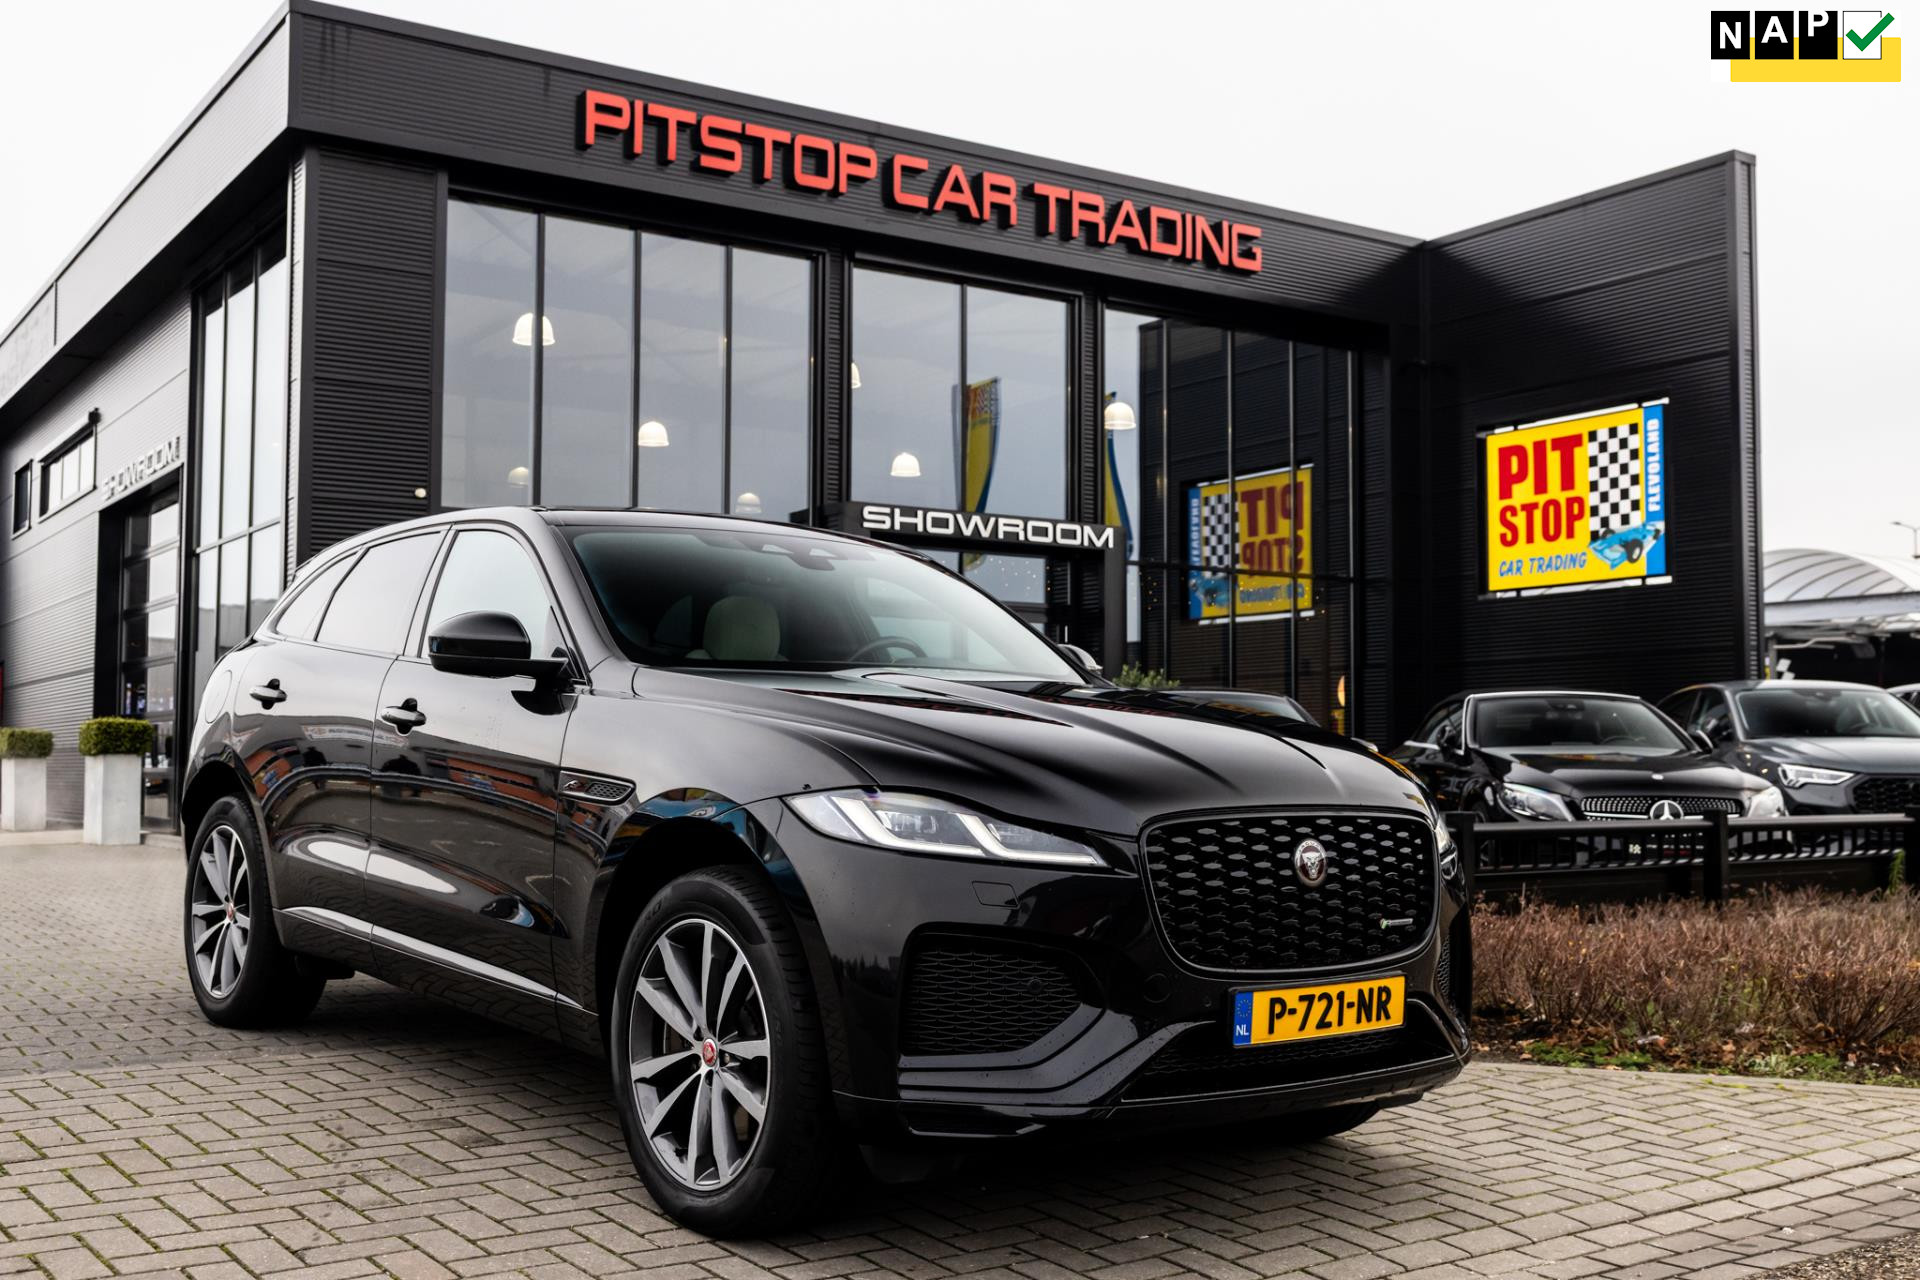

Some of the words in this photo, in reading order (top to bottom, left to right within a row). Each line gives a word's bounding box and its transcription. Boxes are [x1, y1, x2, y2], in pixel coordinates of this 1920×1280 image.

[584, 89, 877, 194] PITSTOP
[893, 154, 1017, 227] CAR
[1033, 183, 1263, 273] TRADING
[1498, 433, 1583, 500] PIT
[1646, 418, 1660, 512] FLEVOLAND
[862, 505, 1114, 549] SHOWROOM
[1499, 496, 1585, 547] STOP
[1499, 560, 1523, 577] CAR
[1529, 552, 1587, 573] TRADING
[1235, 1024, 1249, 1036] NL
[1268, 986, 1392, 1034] P-721-NR
